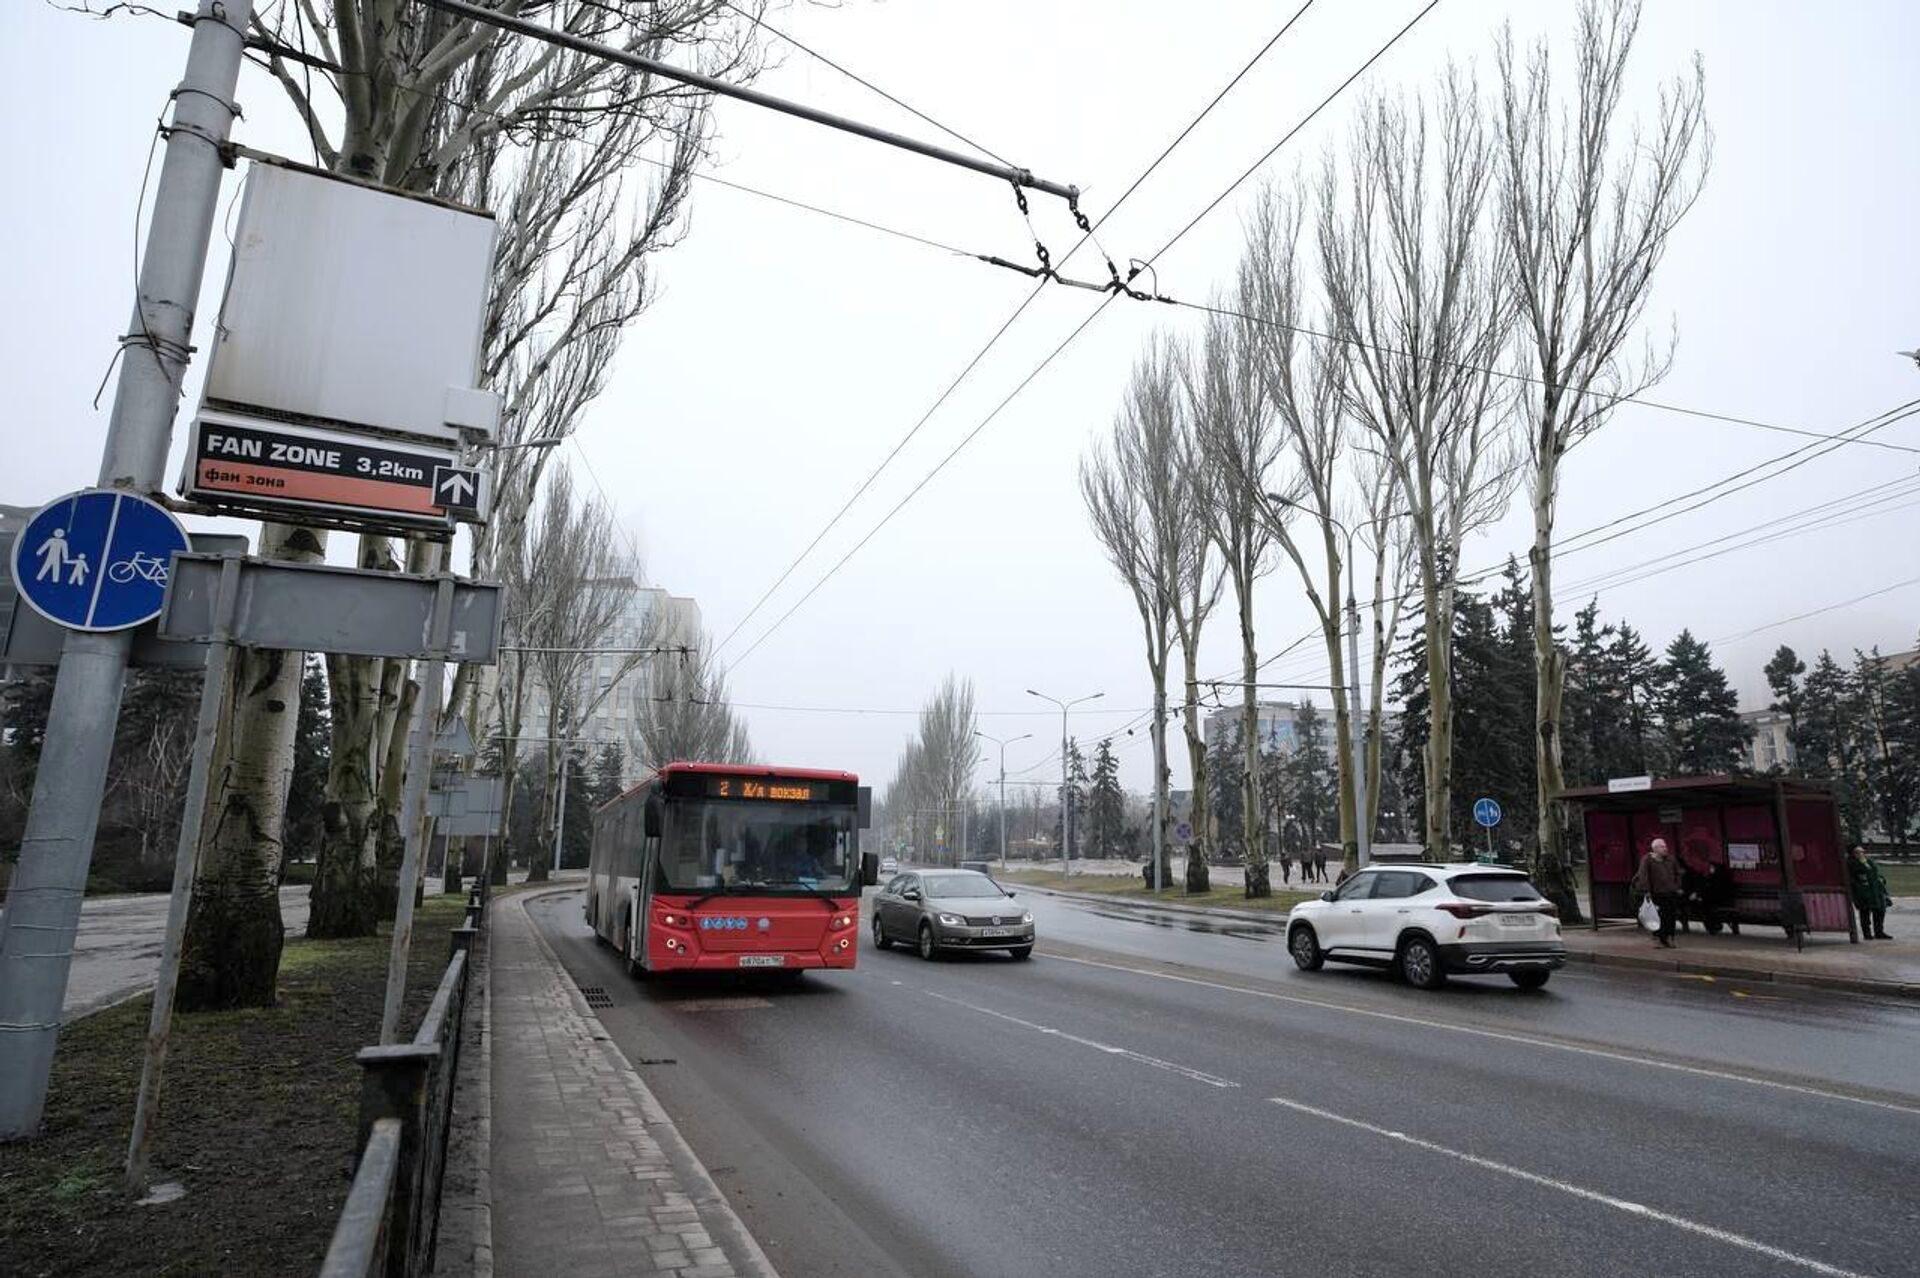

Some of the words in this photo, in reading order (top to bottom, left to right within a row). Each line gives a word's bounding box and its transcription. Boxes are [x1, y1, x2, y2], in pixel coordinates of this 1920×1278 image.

[207, 434, 263, 458] FAN
[269, 443, 341, 468] ZONE
[356, 456, 423, 480] 3,2km
[204, 468, 240, 483] фан
[246, 476, 285, 488] зона
[720, 781, 729, 796] 2
